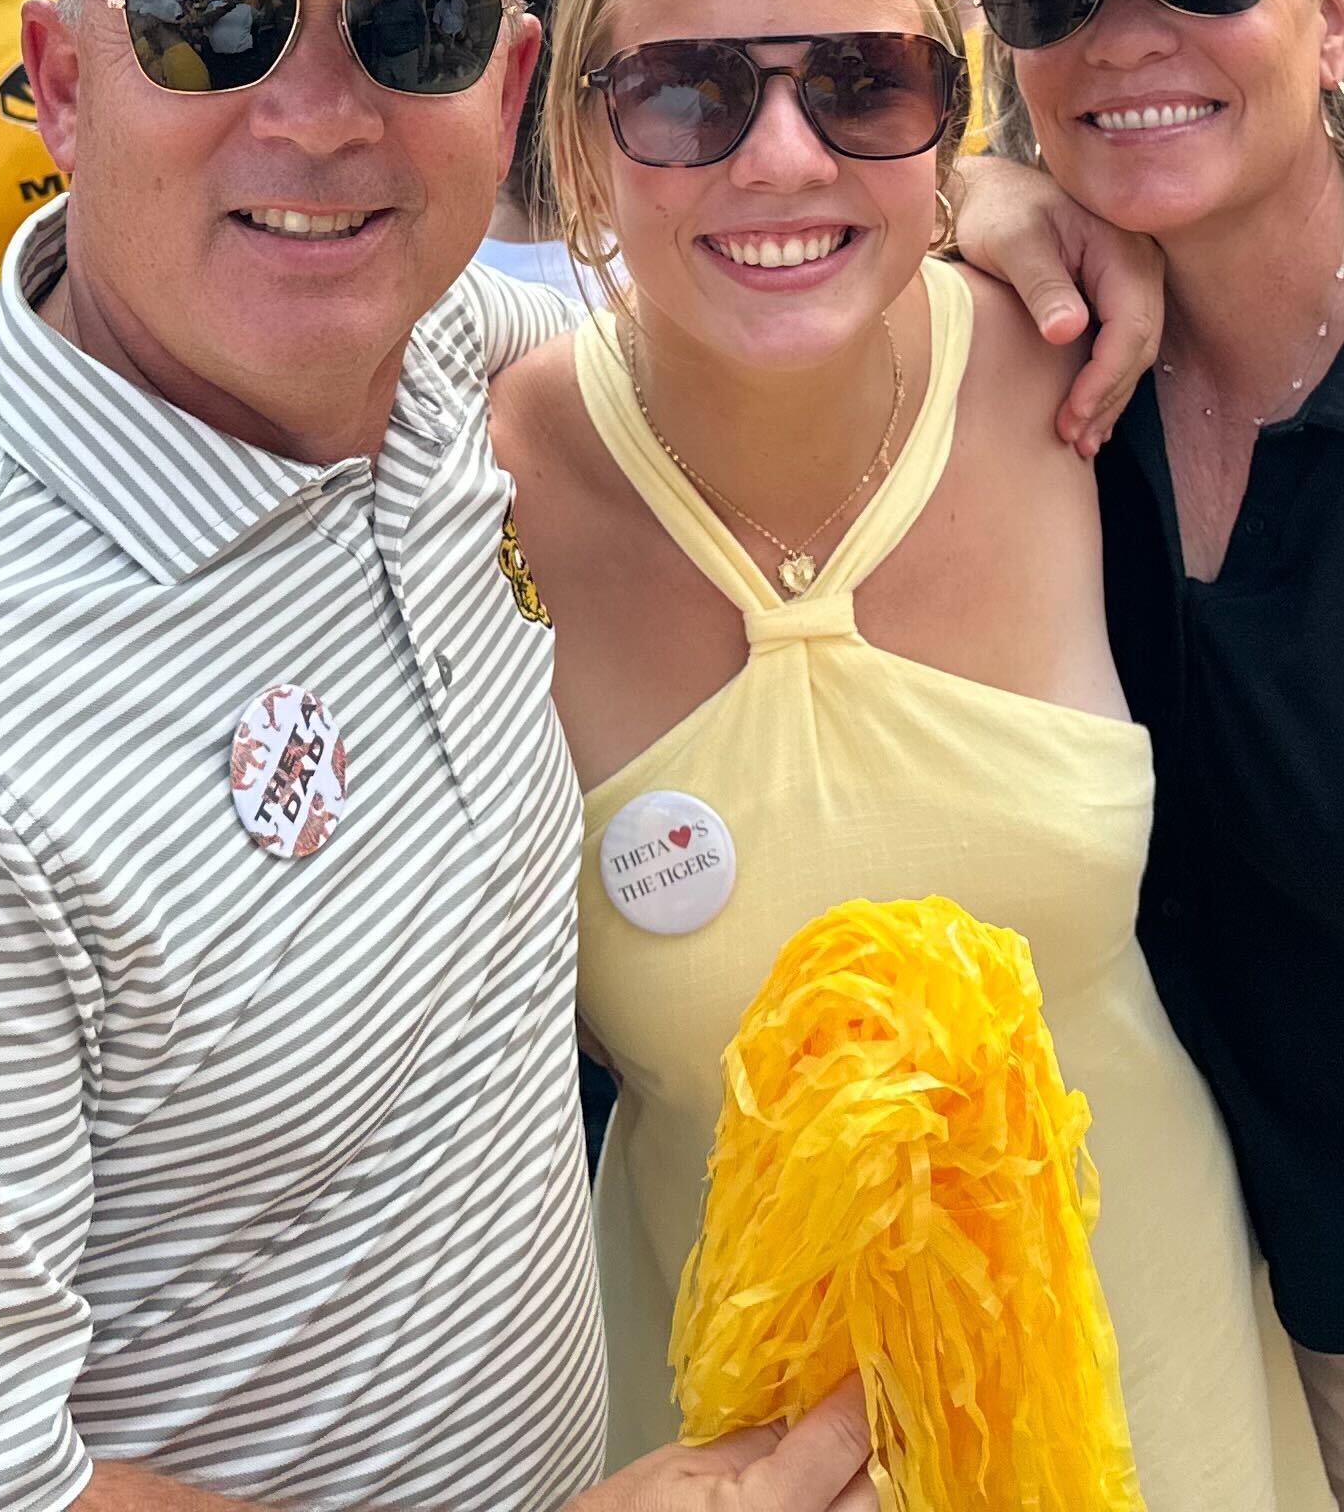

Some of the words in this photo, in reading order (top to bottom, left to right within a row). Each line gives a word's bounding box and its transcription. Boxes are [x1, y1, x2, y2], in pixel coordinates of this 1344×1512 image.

[254, 703, 317, 824] THETA
[282, 734, 325, 824] DAD
[610, 838, 671, 875] THETA
[618, 874, 657, 904] THE
[655, 848, 722, 889] TIGERS
